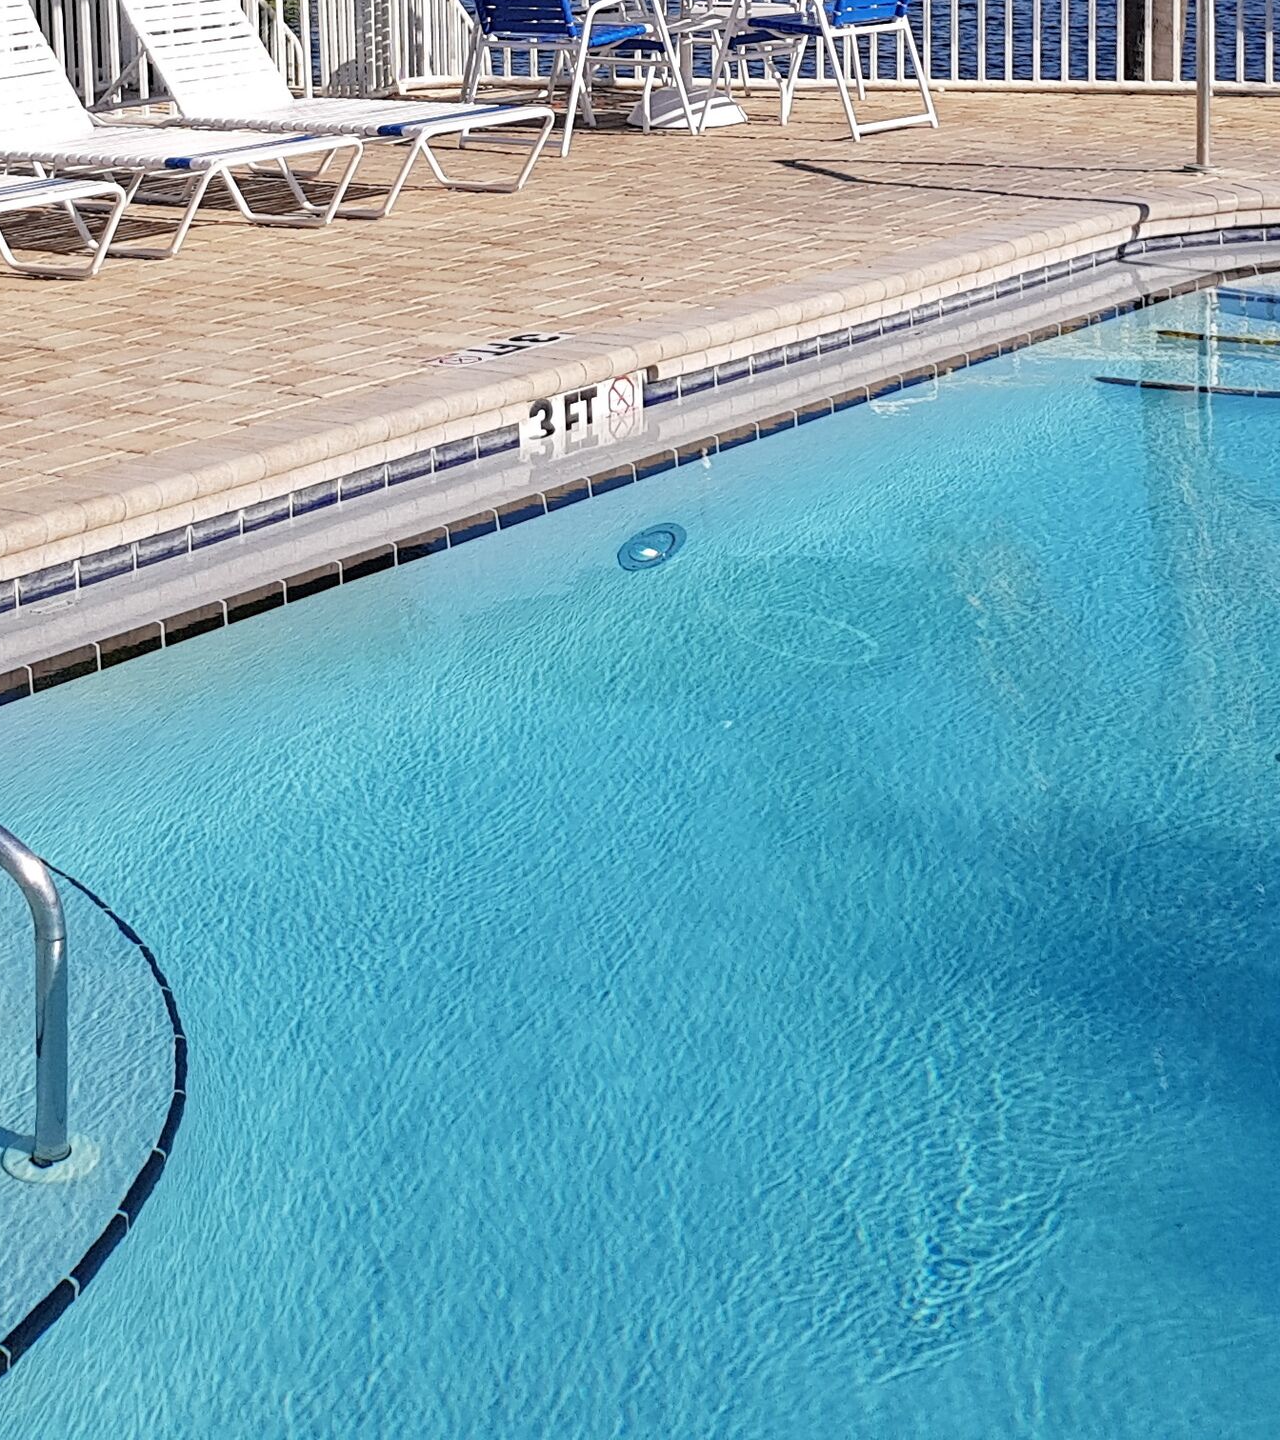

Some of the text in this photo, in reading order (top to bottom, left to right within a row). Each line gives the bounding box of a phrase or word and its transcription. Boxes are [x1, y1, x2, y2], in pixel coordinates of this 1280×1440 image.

[466, 333, 560, 356] 3 FT
[529, 386, 598, 439] 3 FT
